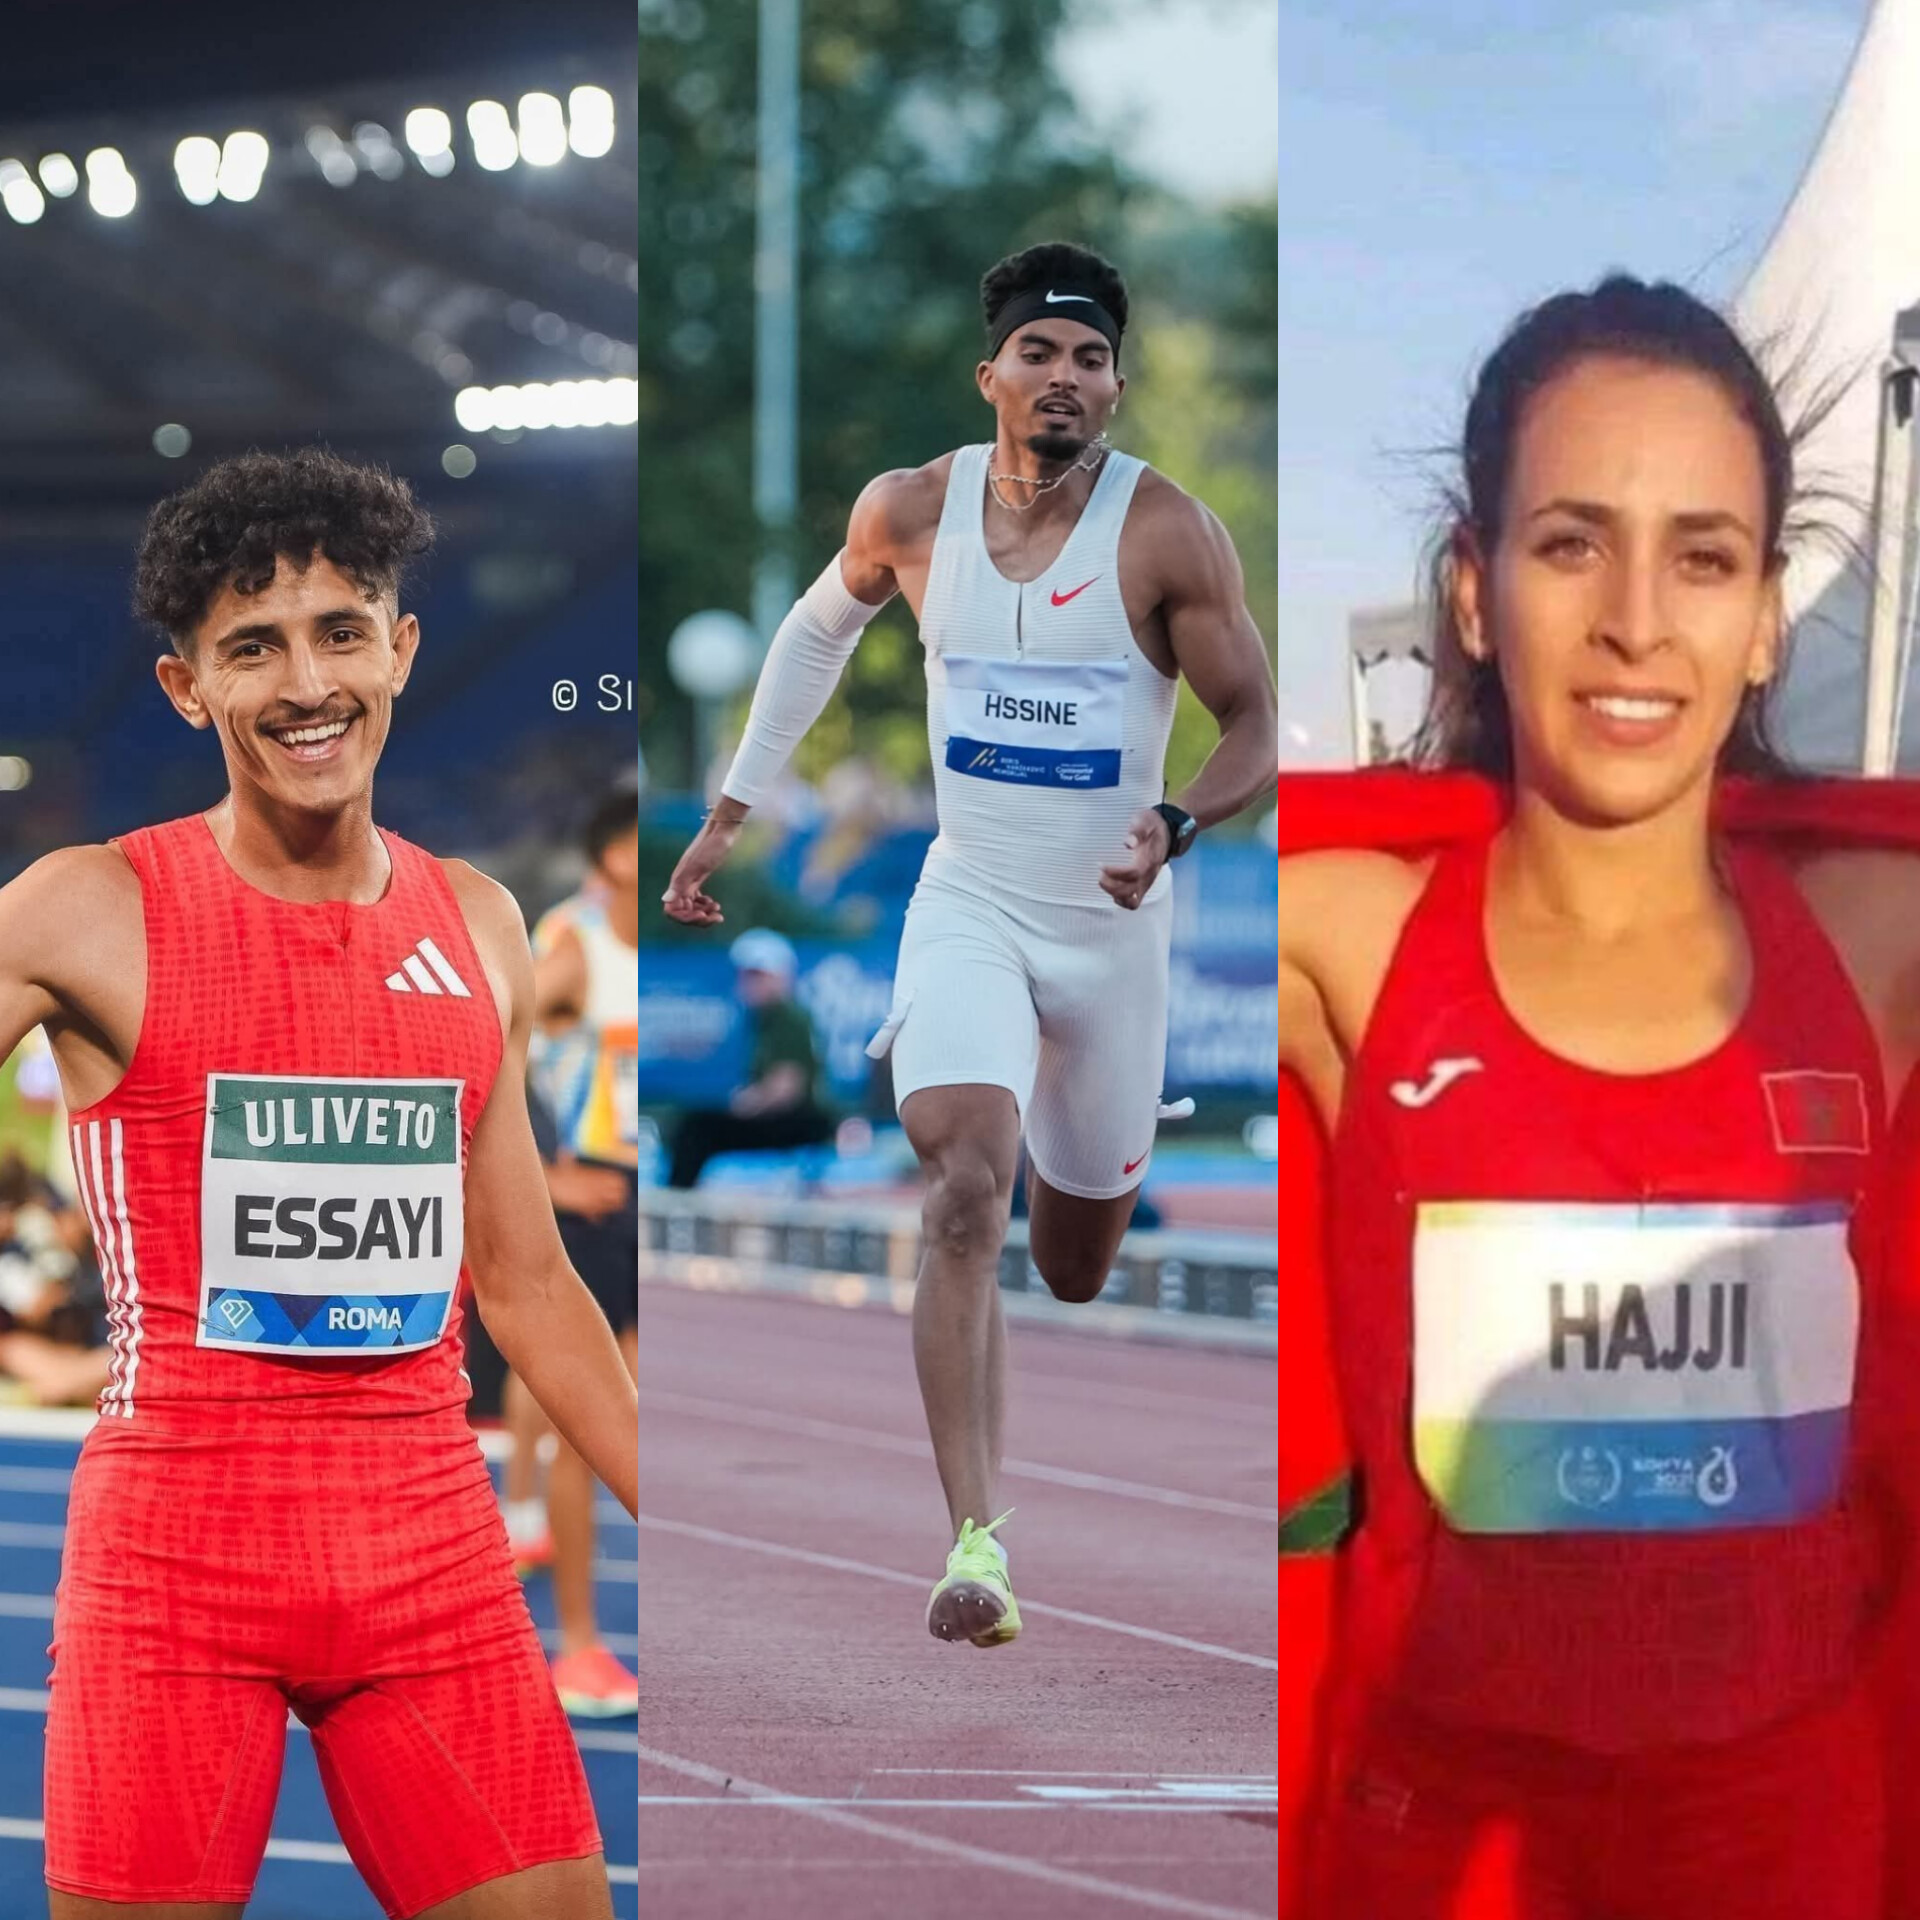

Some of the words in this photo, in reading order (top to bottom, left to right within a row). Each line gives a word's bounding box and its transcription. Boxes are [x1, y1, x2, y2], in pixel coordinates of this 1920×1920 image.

[985, 694, 1077, 726] HSSINE
[245, 1097, 436, 1149] ULIVETO
[235, 1194, 443, 1260] ESSAYI
[328, 1307, 403, 1331] ROMA
[1549, 1283, 1749, 1371] HAJJI
